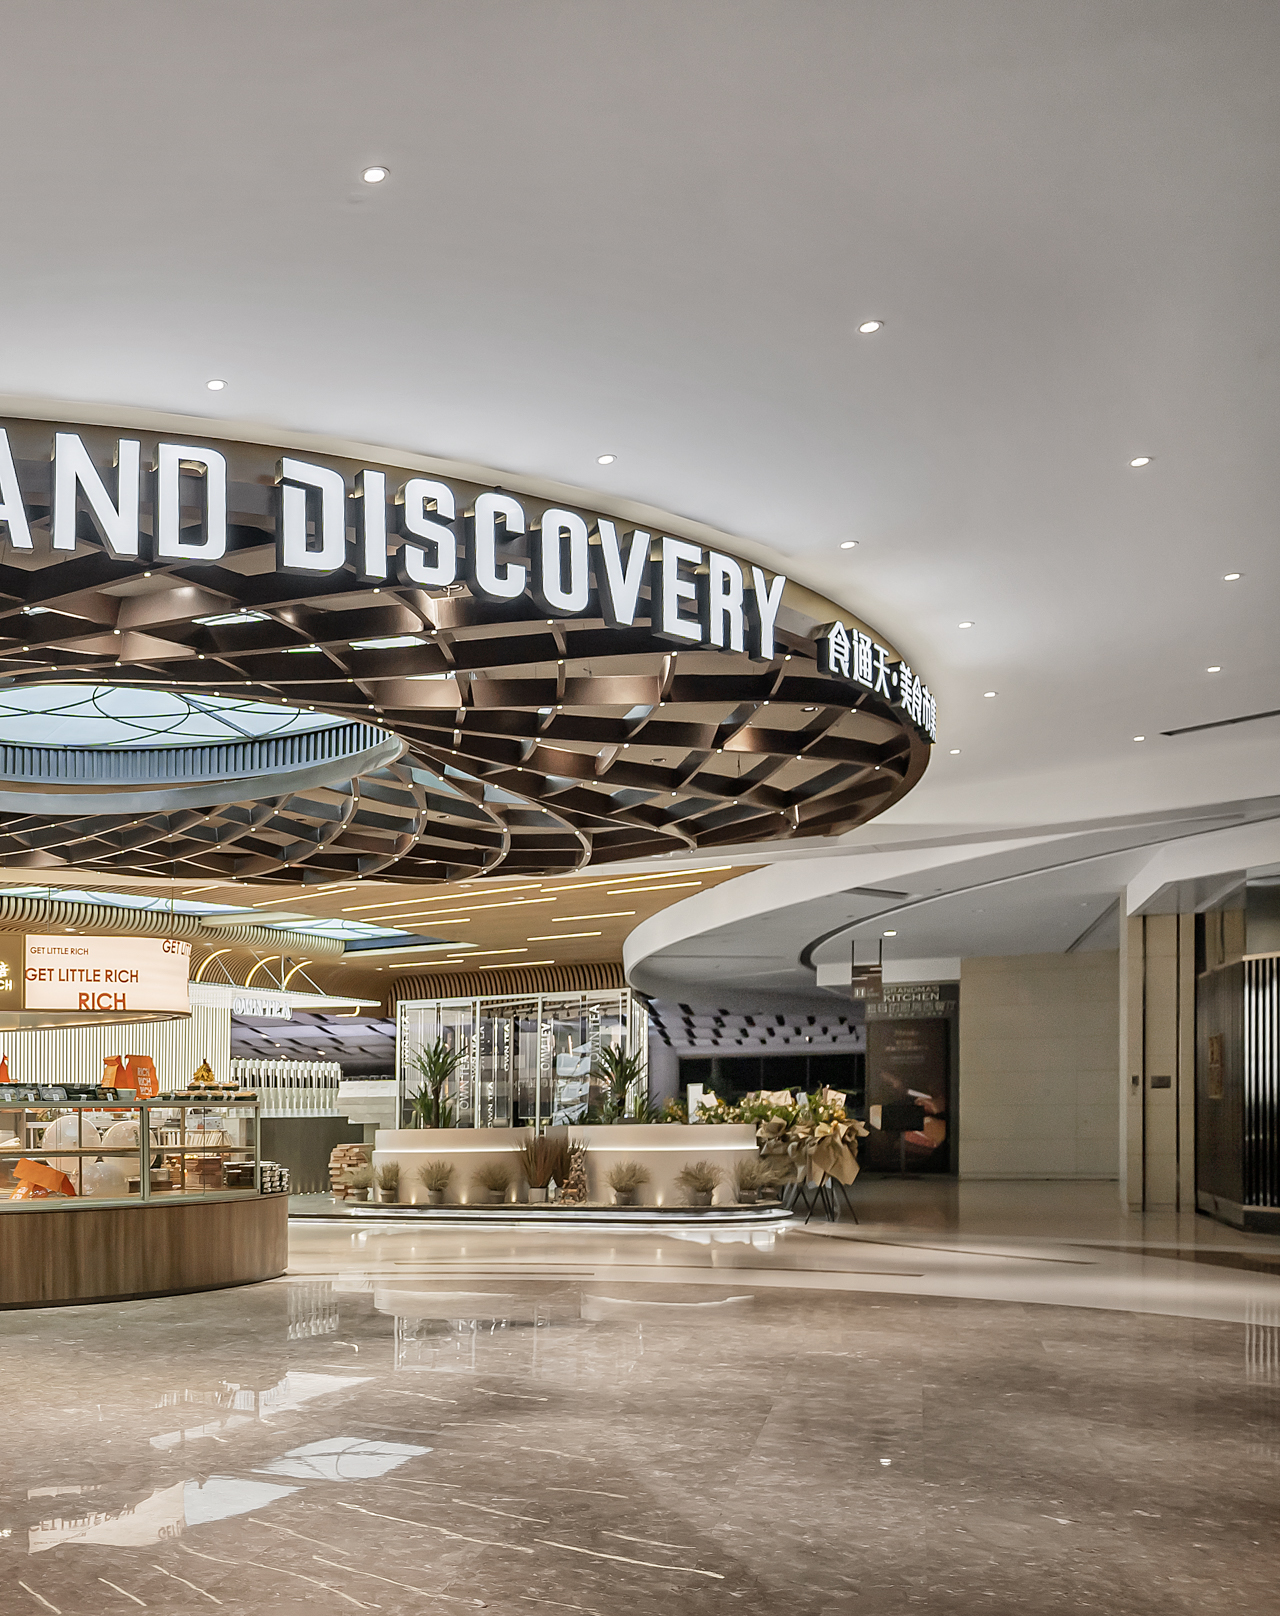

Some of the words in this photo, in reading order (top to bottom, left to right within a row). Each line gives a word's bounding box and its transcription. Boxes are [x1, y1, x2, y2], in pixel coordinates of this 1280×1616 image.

[281, 456, 787, 662] DISCOVERY
[30, 946, 45, 955] GET
[47, 947, 69, 955] LITTLE
[162, 939, 180, 955] GET
[25, 967, 54, 981] GET
[59, 969, 101, 982] LITTLE
[105, 970, 139, 983] RICH
[78, 992, 127, 1010] RICH
[883, 992, 940, 1003] KITCHEN
[589, 1004, 600, 1028] TEA
[589, 1032, 600, 1062] OWN
[138, 1077, 151, 1086] RICH
[460, 1081, 469, 1109] OWN
